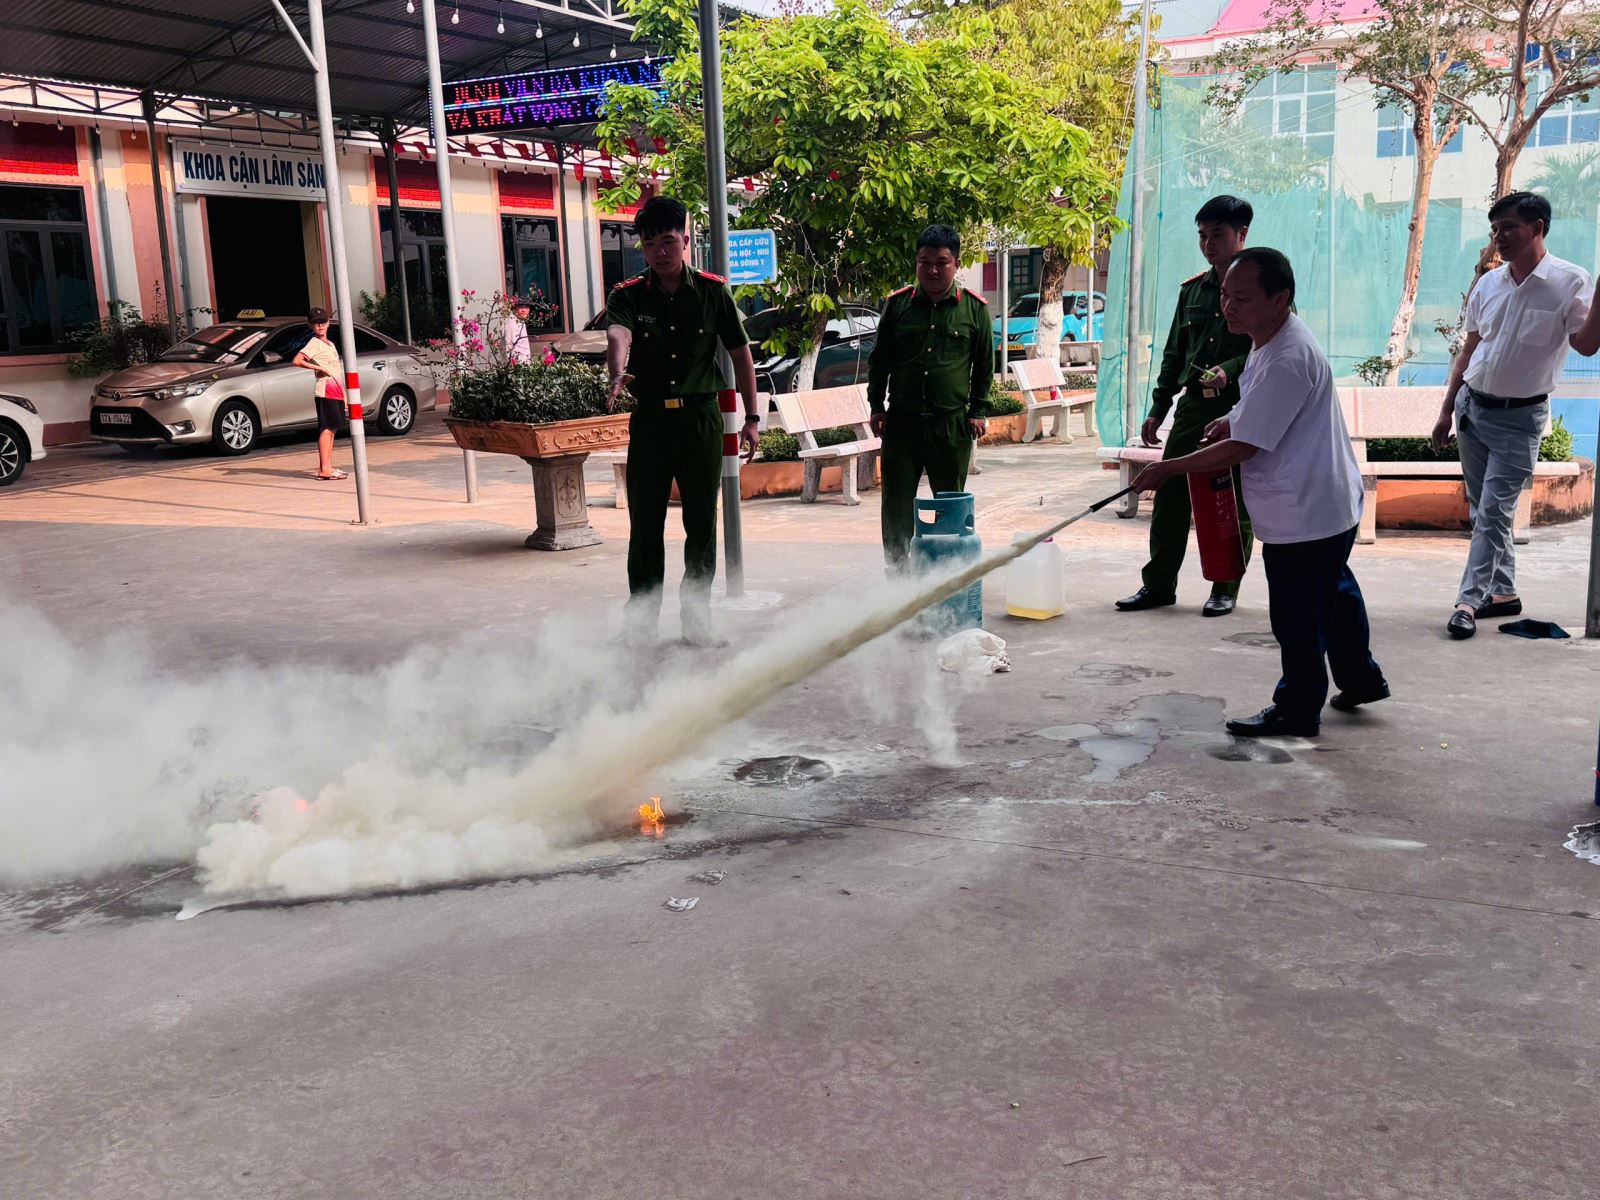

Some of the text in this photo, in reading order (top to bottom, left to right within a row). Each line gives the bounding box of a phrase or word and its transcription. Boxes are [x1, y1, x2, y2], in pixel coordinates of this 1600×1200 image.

[183, 151, 326, 189] KHOA CẬN LÂM SÀN
